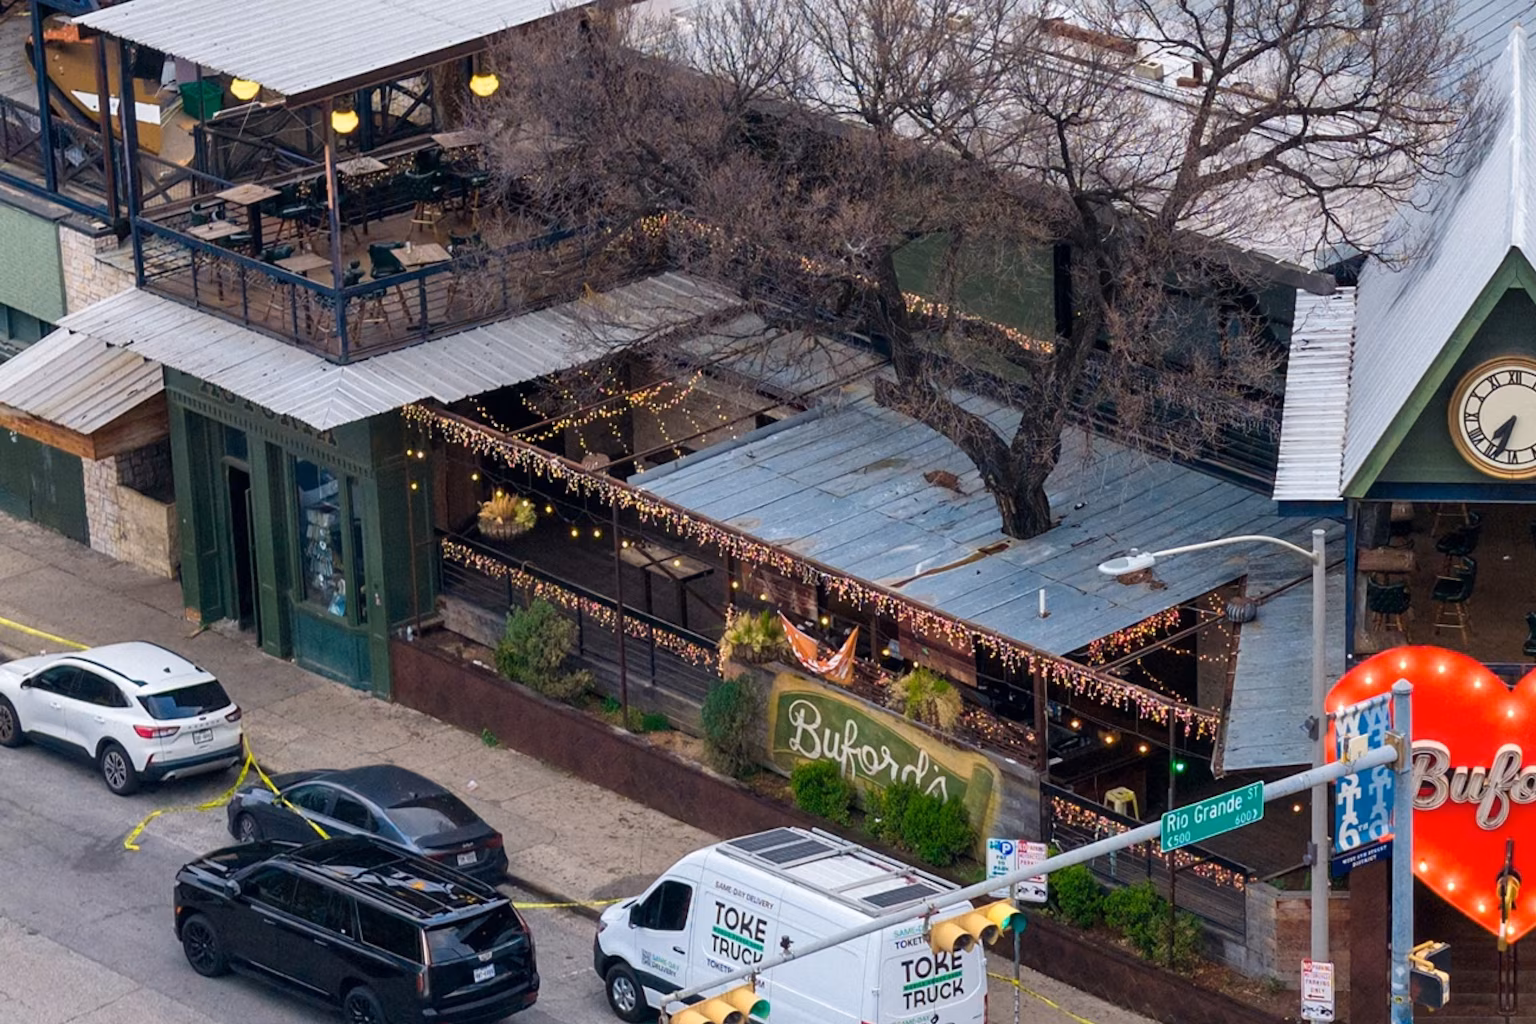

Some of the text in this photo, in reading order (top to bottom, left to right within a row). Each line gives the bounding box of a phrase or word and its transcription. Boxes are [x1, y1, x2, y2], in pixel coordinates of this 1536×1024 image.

[1487, 375, 1501, 390] XI
[1508, 371, 1522, 385] XII
[1470, 391, 1485, 402] X
[1167, 785, 1259, 833] Rio Grande ST
[1235, 810, 1252, 825] 600
[1173, 831, 1191, 846] 500
[746, 893, 774, 910] DELIVERY
[715, 901, 767, 943] TOKE
[901, 949, 962, 983] TOKE
[903, 978, 964, 1009] TRUCK
